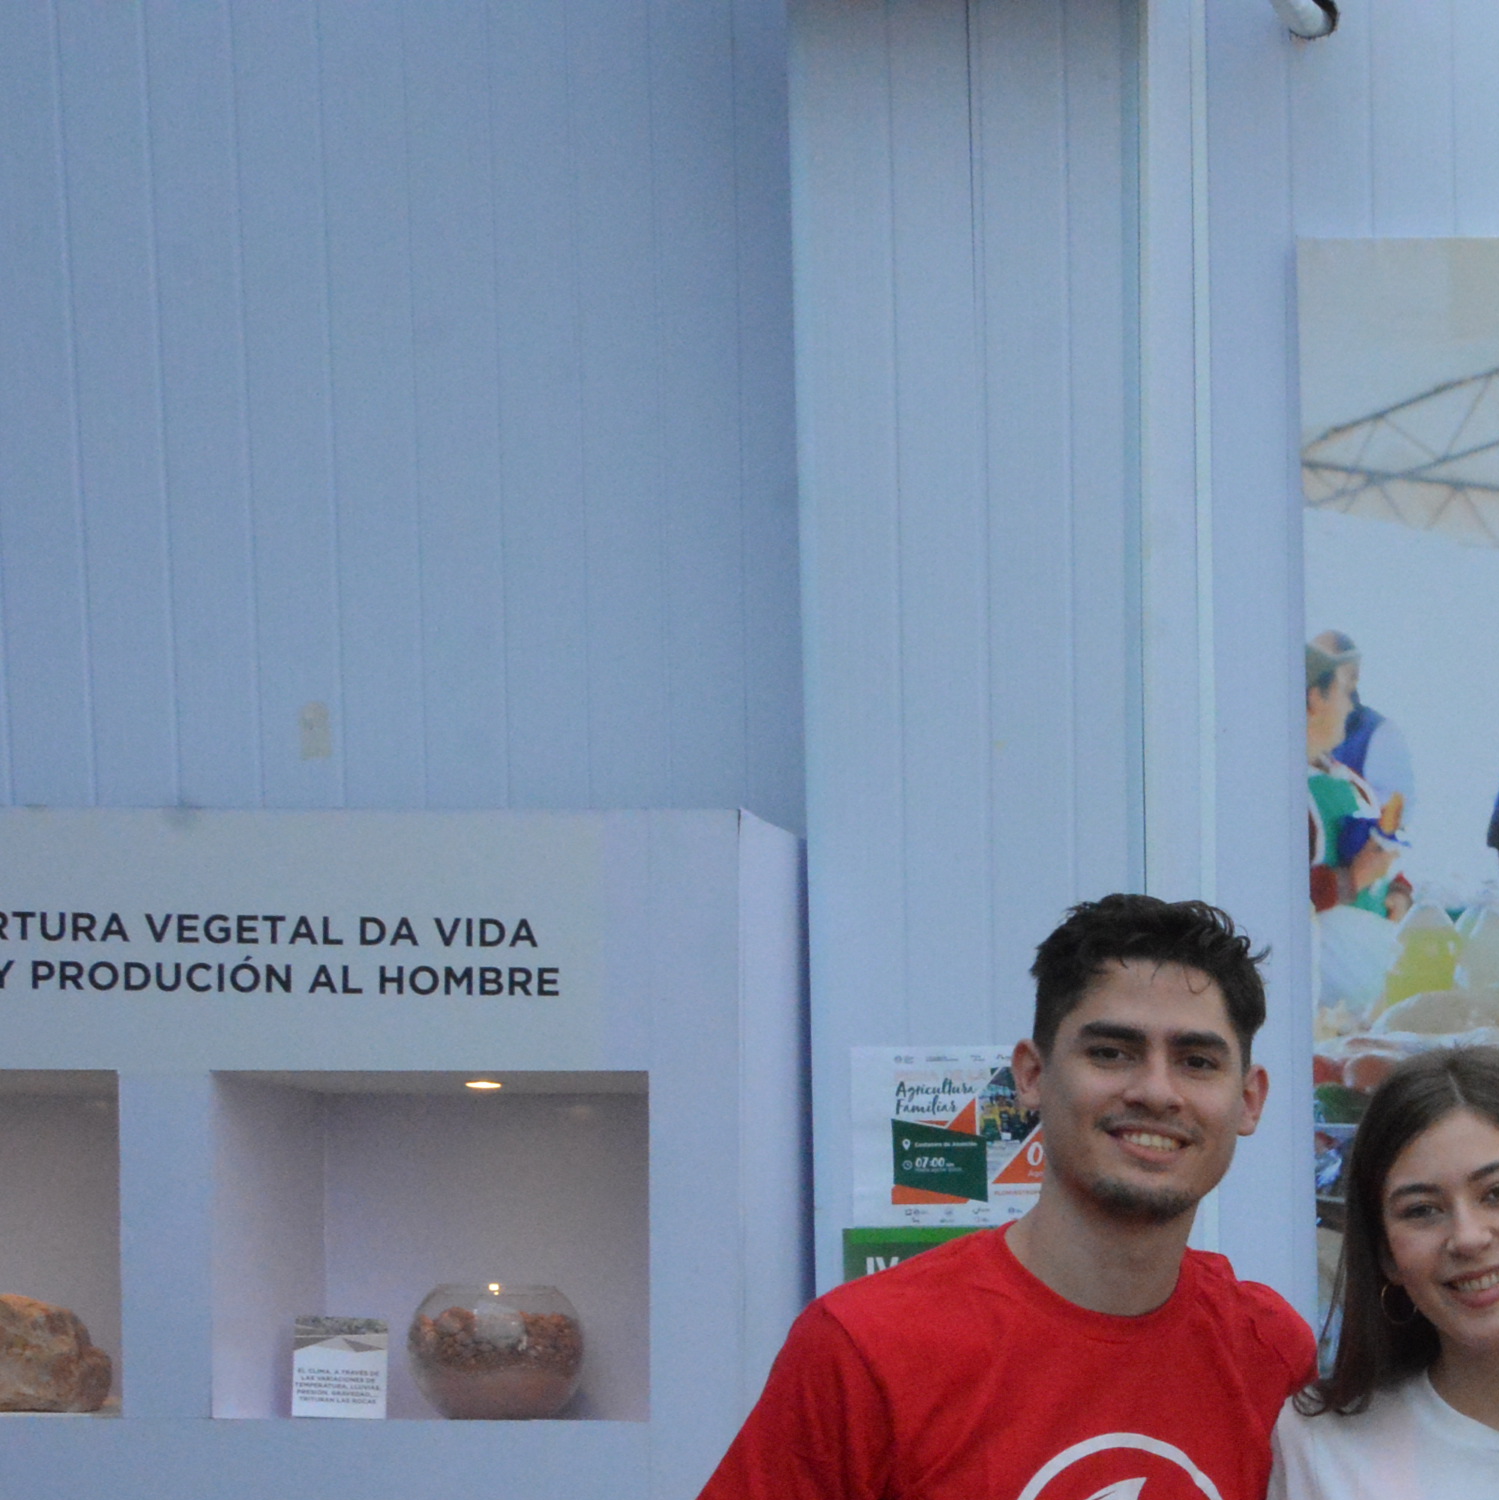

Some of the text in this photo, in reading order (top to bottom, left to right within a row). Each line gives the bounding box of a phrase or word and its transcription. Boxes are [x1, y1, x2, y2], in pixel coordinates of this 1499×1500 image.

[144, 913, 344, 946] VEGETAL
[359, 916, 419, 947] DA
[433, 917, 538, 948] VIDA
[31, 955, 292, 993] PRODUCIÓN
[308, 964, 363, 994] AL
[379, 965, 560, 997] HOMBRE
[895, 1077, 976, 1103] Agricultura
[895, 1095, 958, 1115] Familiar
[914, 1156, 945, 1169] 07:00
[1026, 1141, 1045, 1167] 0
